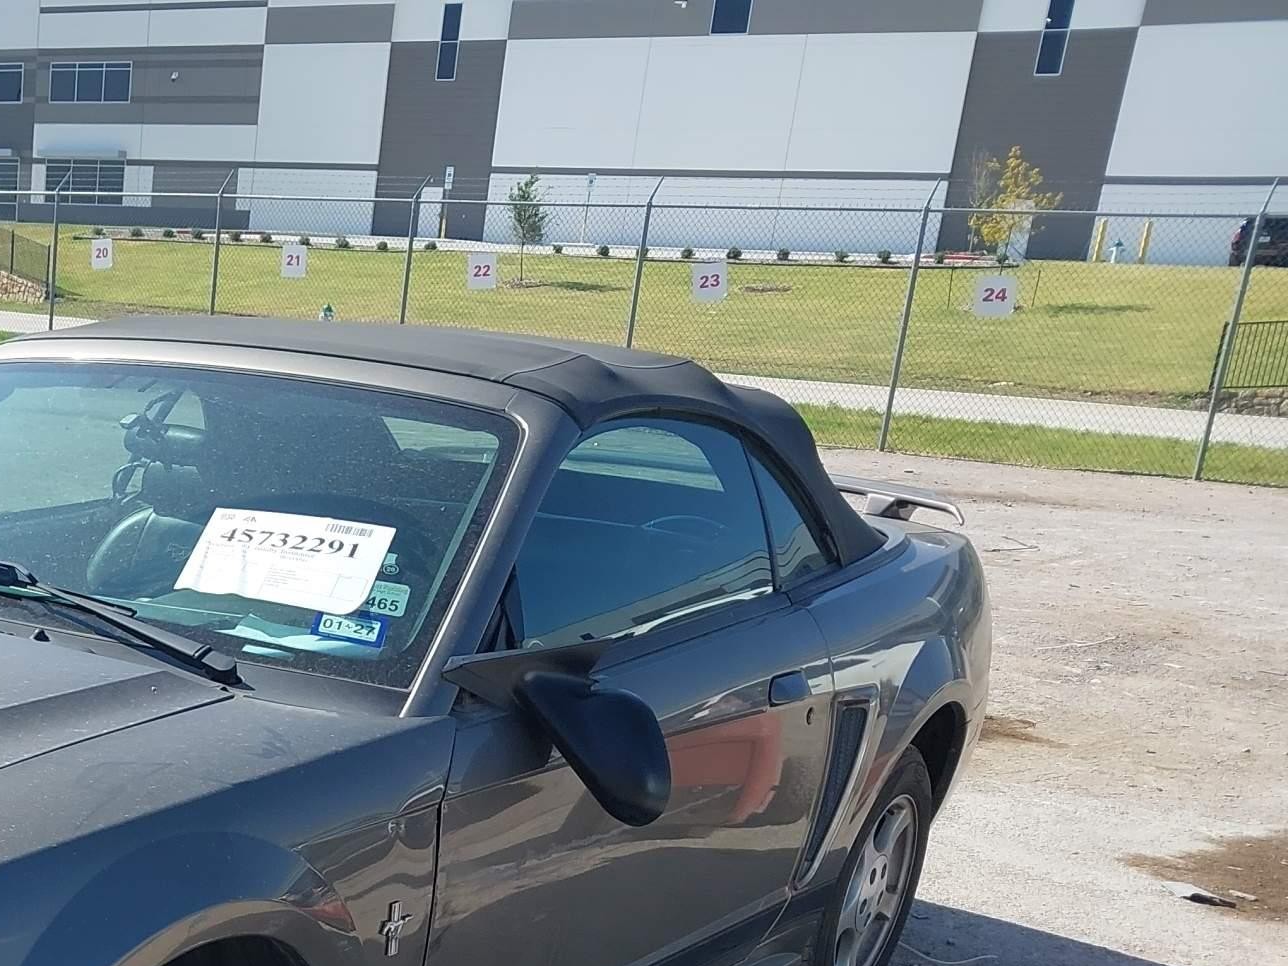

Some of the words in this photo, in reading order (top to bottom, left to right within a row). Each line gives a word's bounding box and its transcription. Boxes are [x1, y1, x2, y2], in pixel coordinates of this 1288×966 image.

[95, 247, 109, 259] 20
[286, 254, 301, 267] 21
[473, 264, 491, 278] 22
[699, 273, 721, 289] 23
[982, 287, 1008, 302] 24
[220, 527, 360, 559] 45732291
